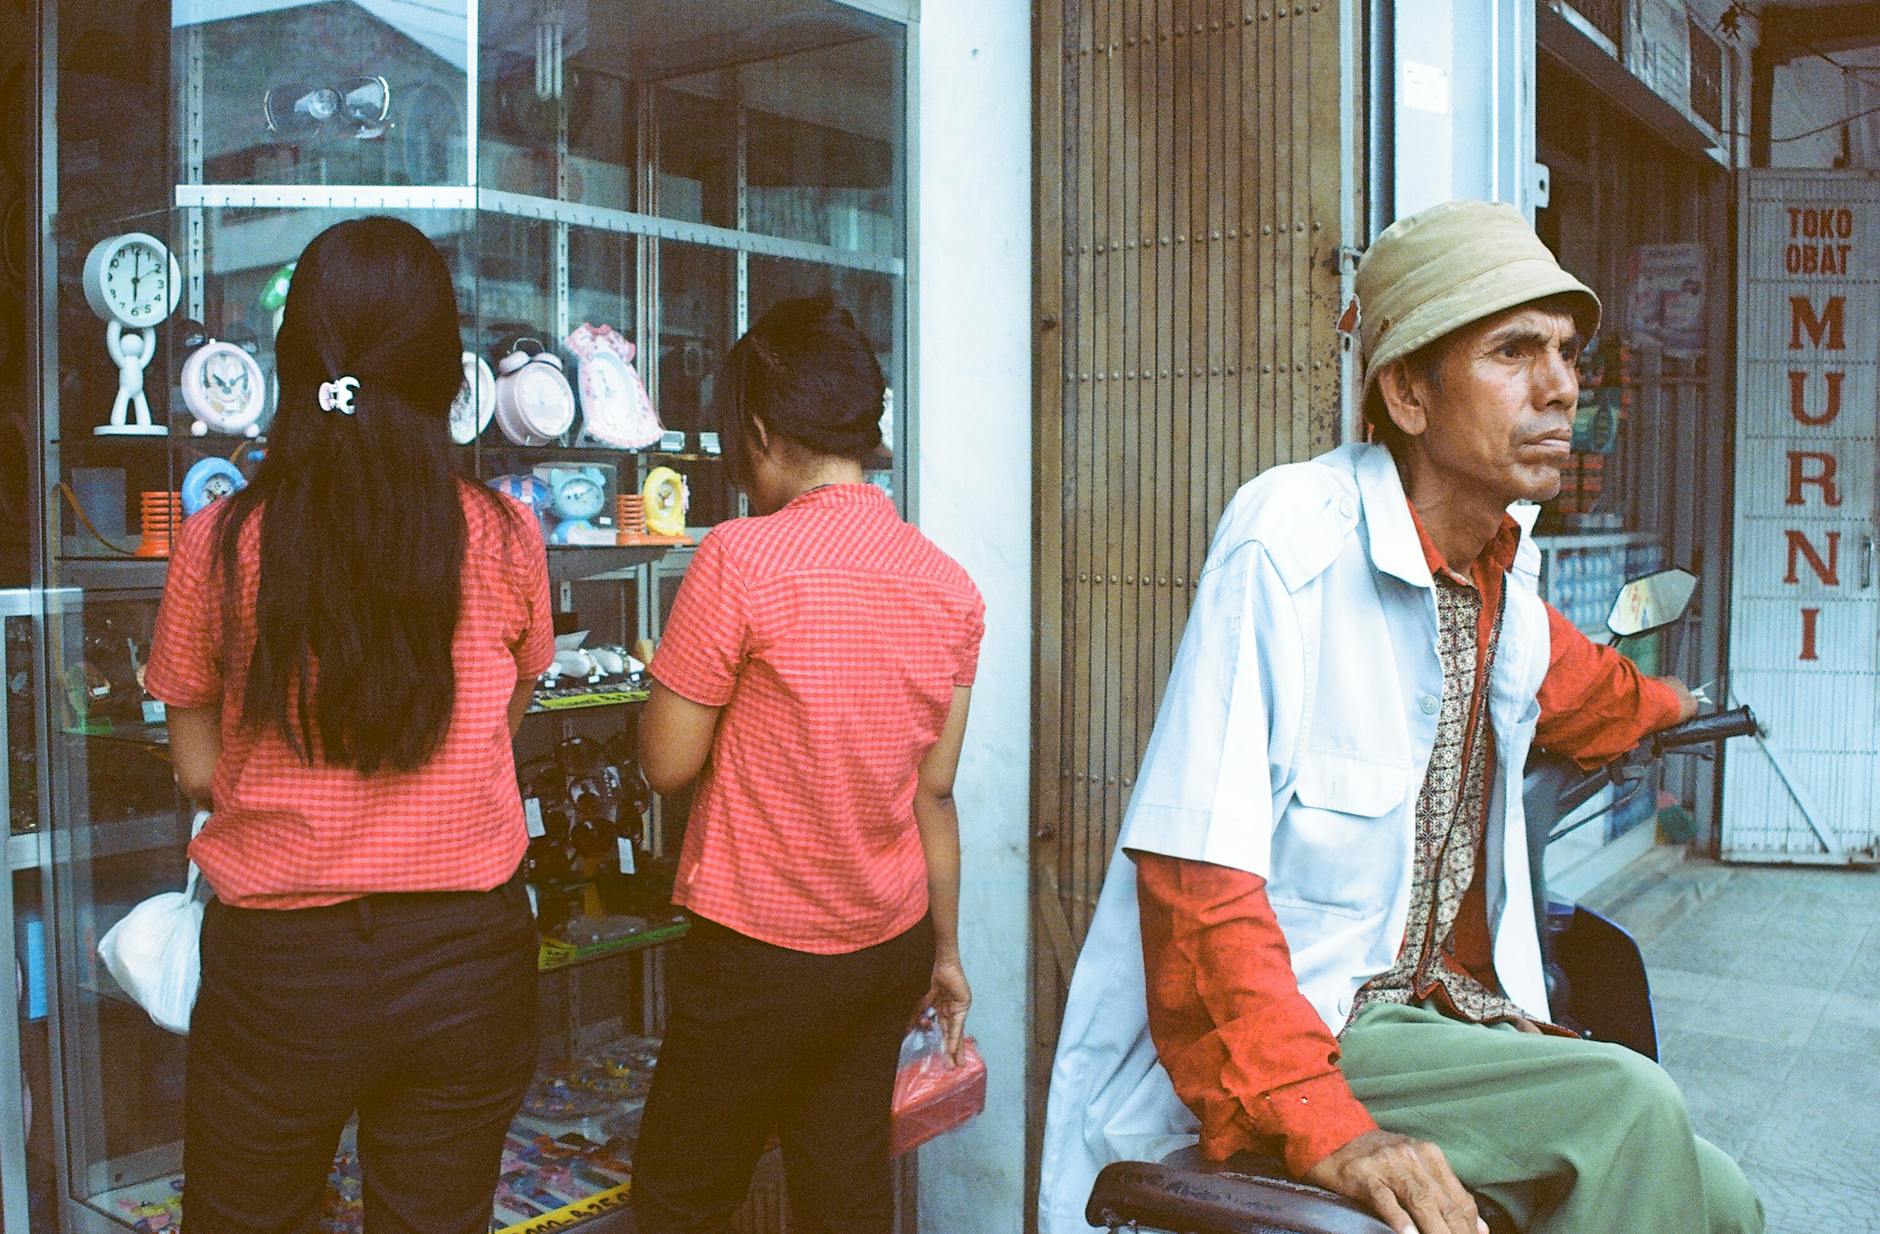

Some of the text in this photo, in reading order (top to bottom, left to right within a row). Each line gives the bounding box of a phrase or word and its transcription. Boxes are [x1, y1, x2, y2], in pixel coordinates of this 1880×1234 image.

[1786, 207, 1853, 240] TOKO
[1785, 244, 1853, 275] OBAT
[154, 263, 162, 274] 2
[154, 294, 161, 302] 4
[130, 307, 140, 317] 6
[144, 304, 152, 314] 5
[1783, 295, 1846, 661] MURNI
